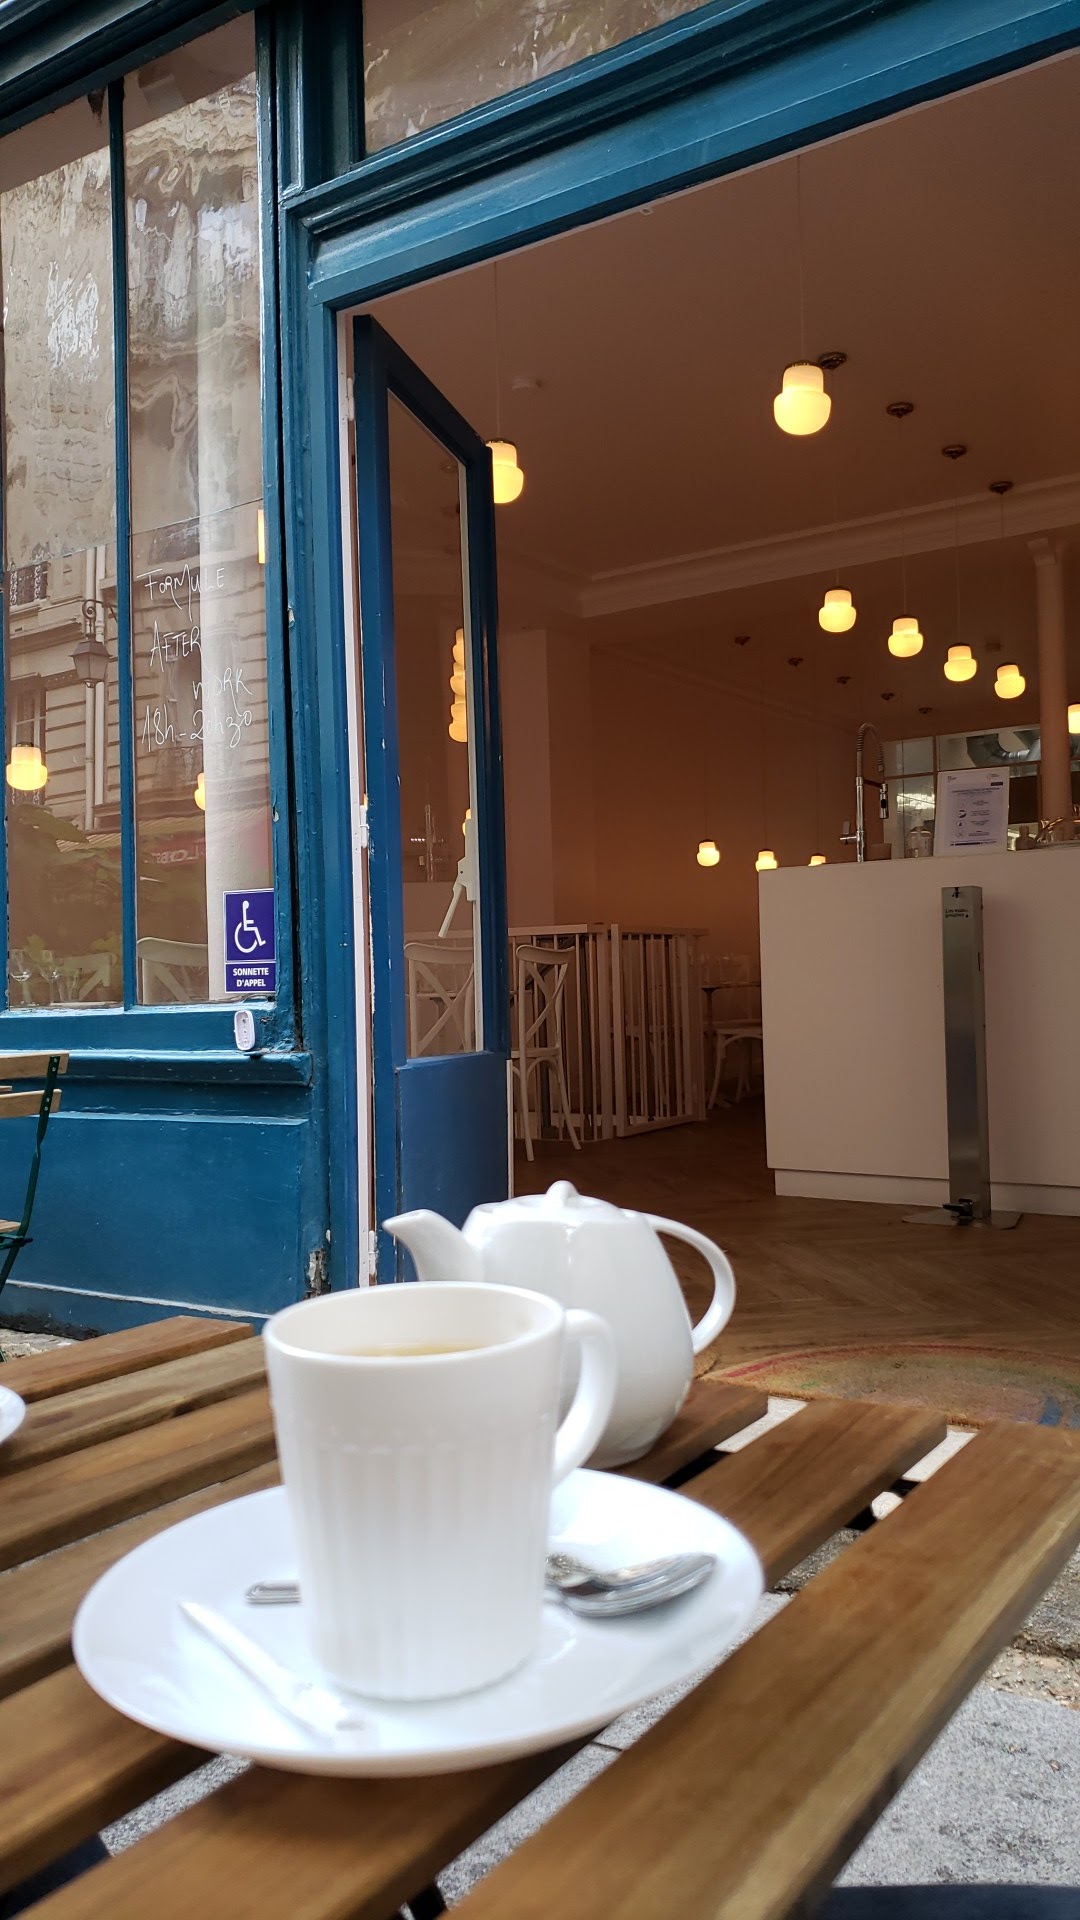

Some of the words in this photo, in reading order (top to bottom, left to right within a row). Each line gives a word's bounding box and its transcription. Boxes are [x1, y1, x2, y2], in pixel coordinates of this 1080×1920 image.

[137, 564, 224, 621] FORMULE
[150, 620, 210, 672] AFTER
[233, 967, 269, 976] SONNETTE
[236, 979, 266, 987] D'APPEL
